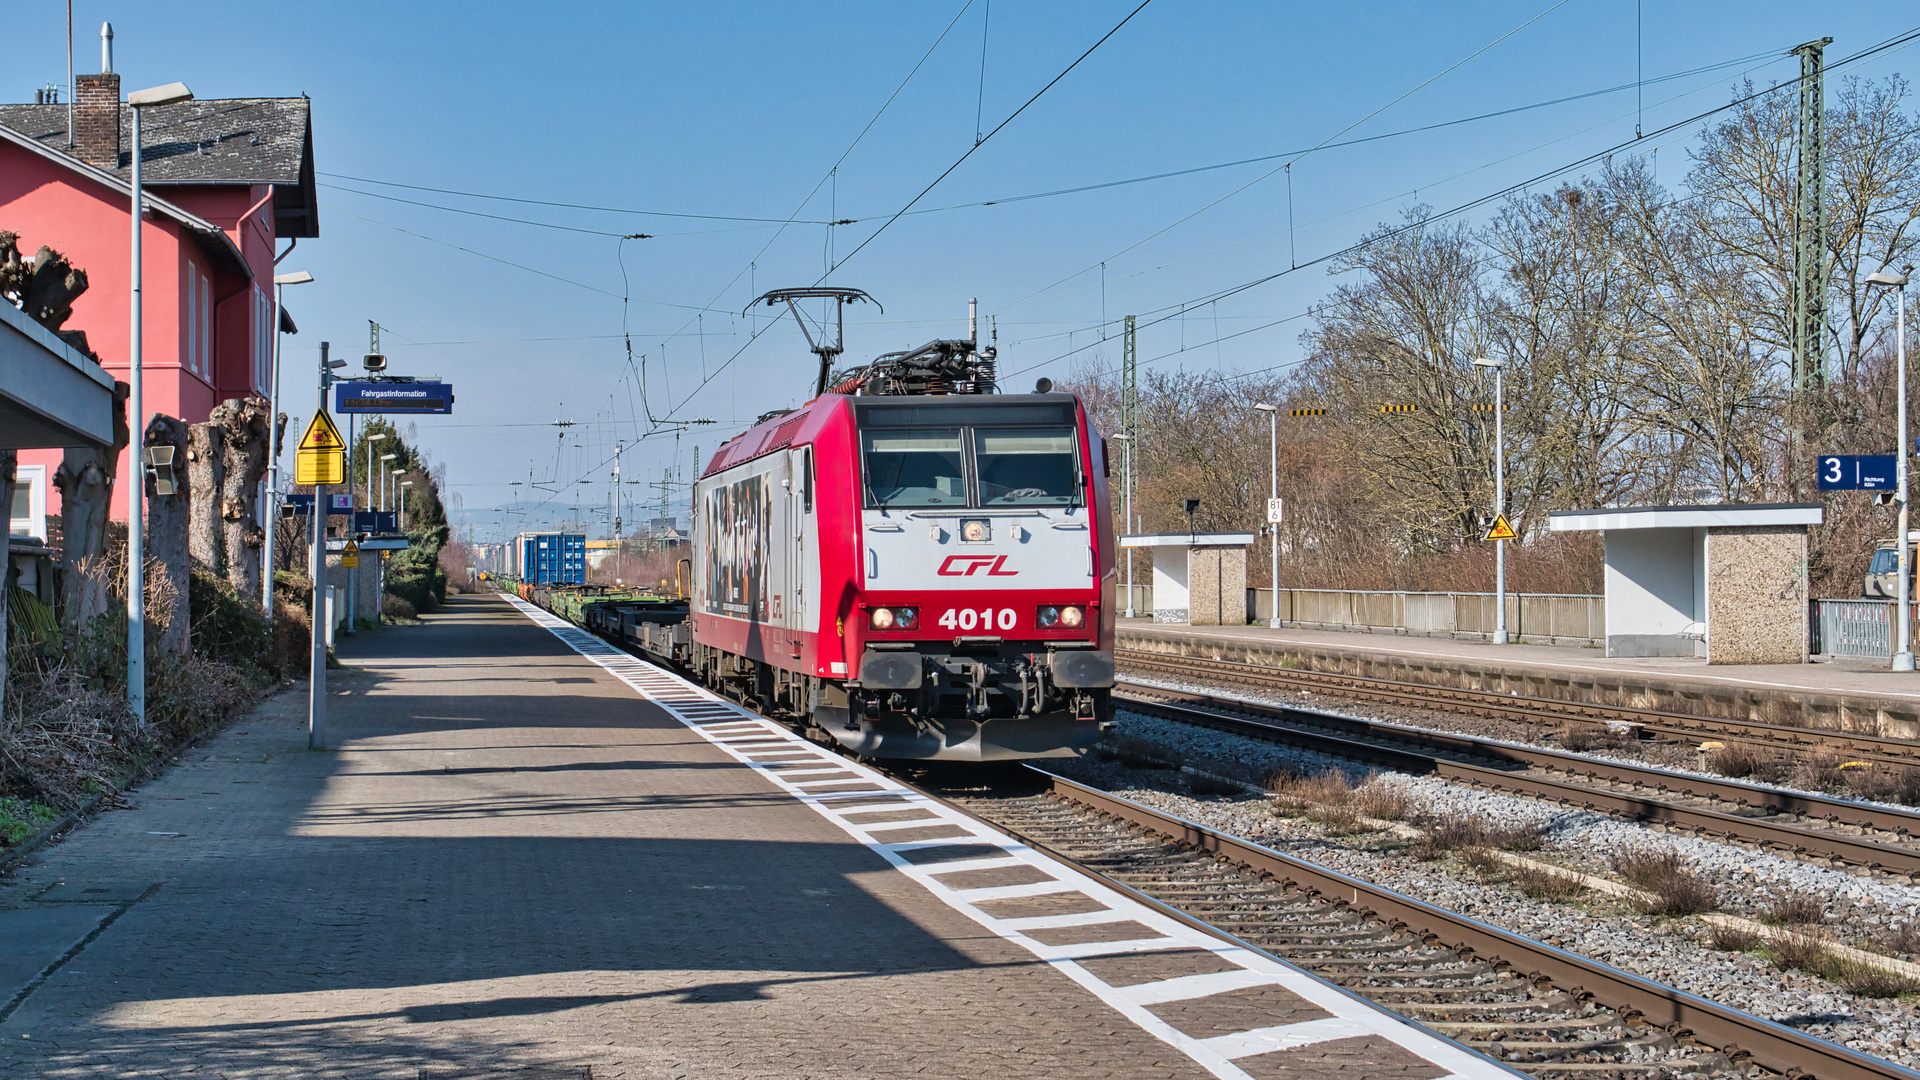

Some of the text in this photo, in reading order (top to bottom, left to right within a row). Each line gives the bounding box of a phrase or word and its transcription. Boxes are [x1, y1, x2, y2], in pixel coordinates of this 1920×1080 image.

[361, 389, 427, 399] Fahrgastinformation
[1824, 457, 1842, 483] 3
[1270, 500, 1280, 509] 81
[389, 513, 396, 528] 1
[1271, 511, 1279, 520] 6
[937, 555, 1020, 576] CFL
[938, 608, 1017, 630] 4010
